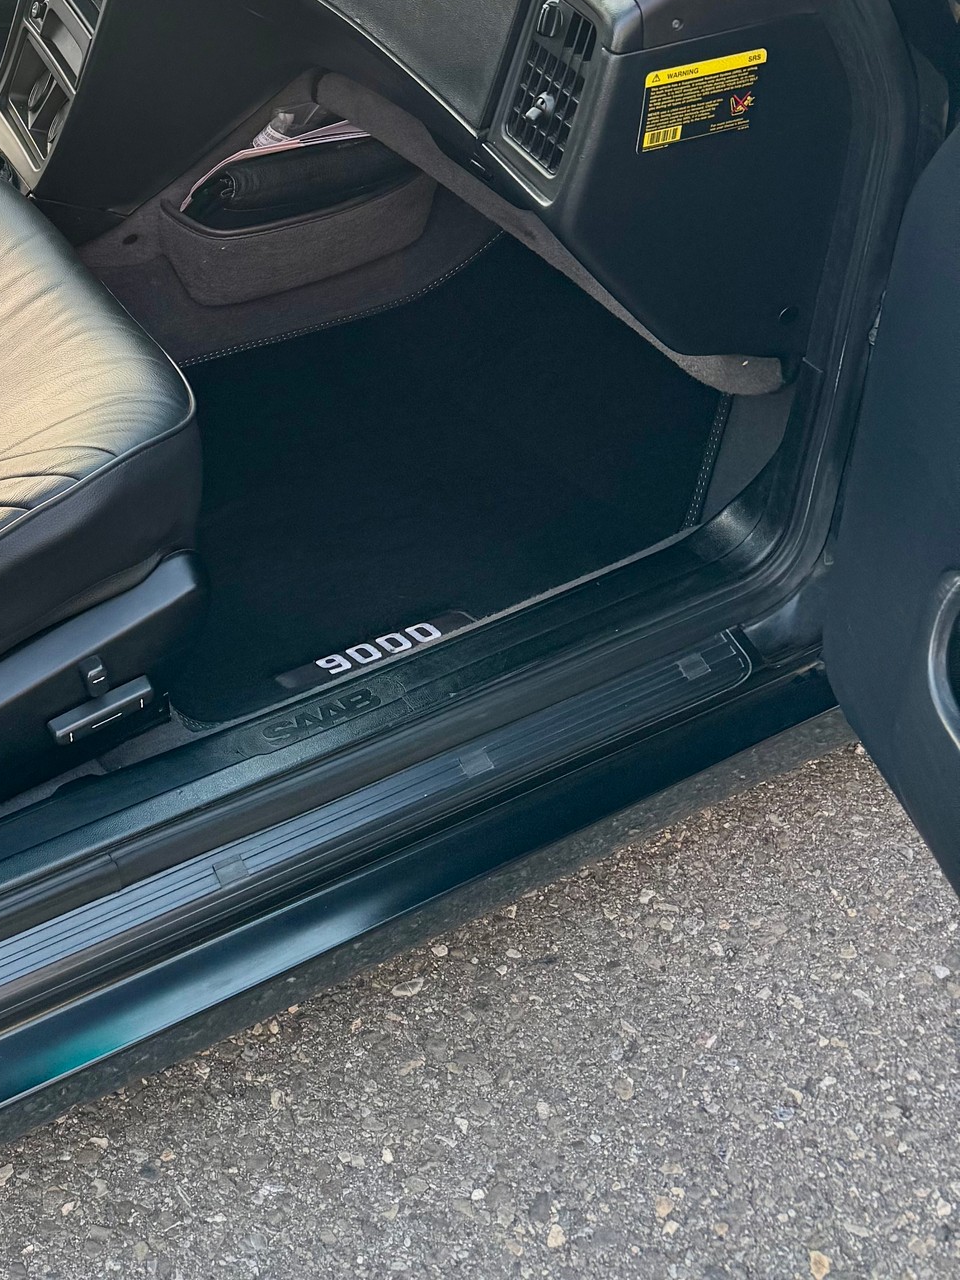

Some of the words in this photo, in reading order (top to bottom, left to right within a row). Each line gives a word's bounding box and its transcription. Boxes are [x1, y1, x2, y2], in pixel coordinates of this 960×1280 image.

[667, 67, 699, 80] WARNING
[747, 53, 761, 63] SRS
[315, 622, 442, 675] 9000
[262, 688, 382, 741] SAAB
